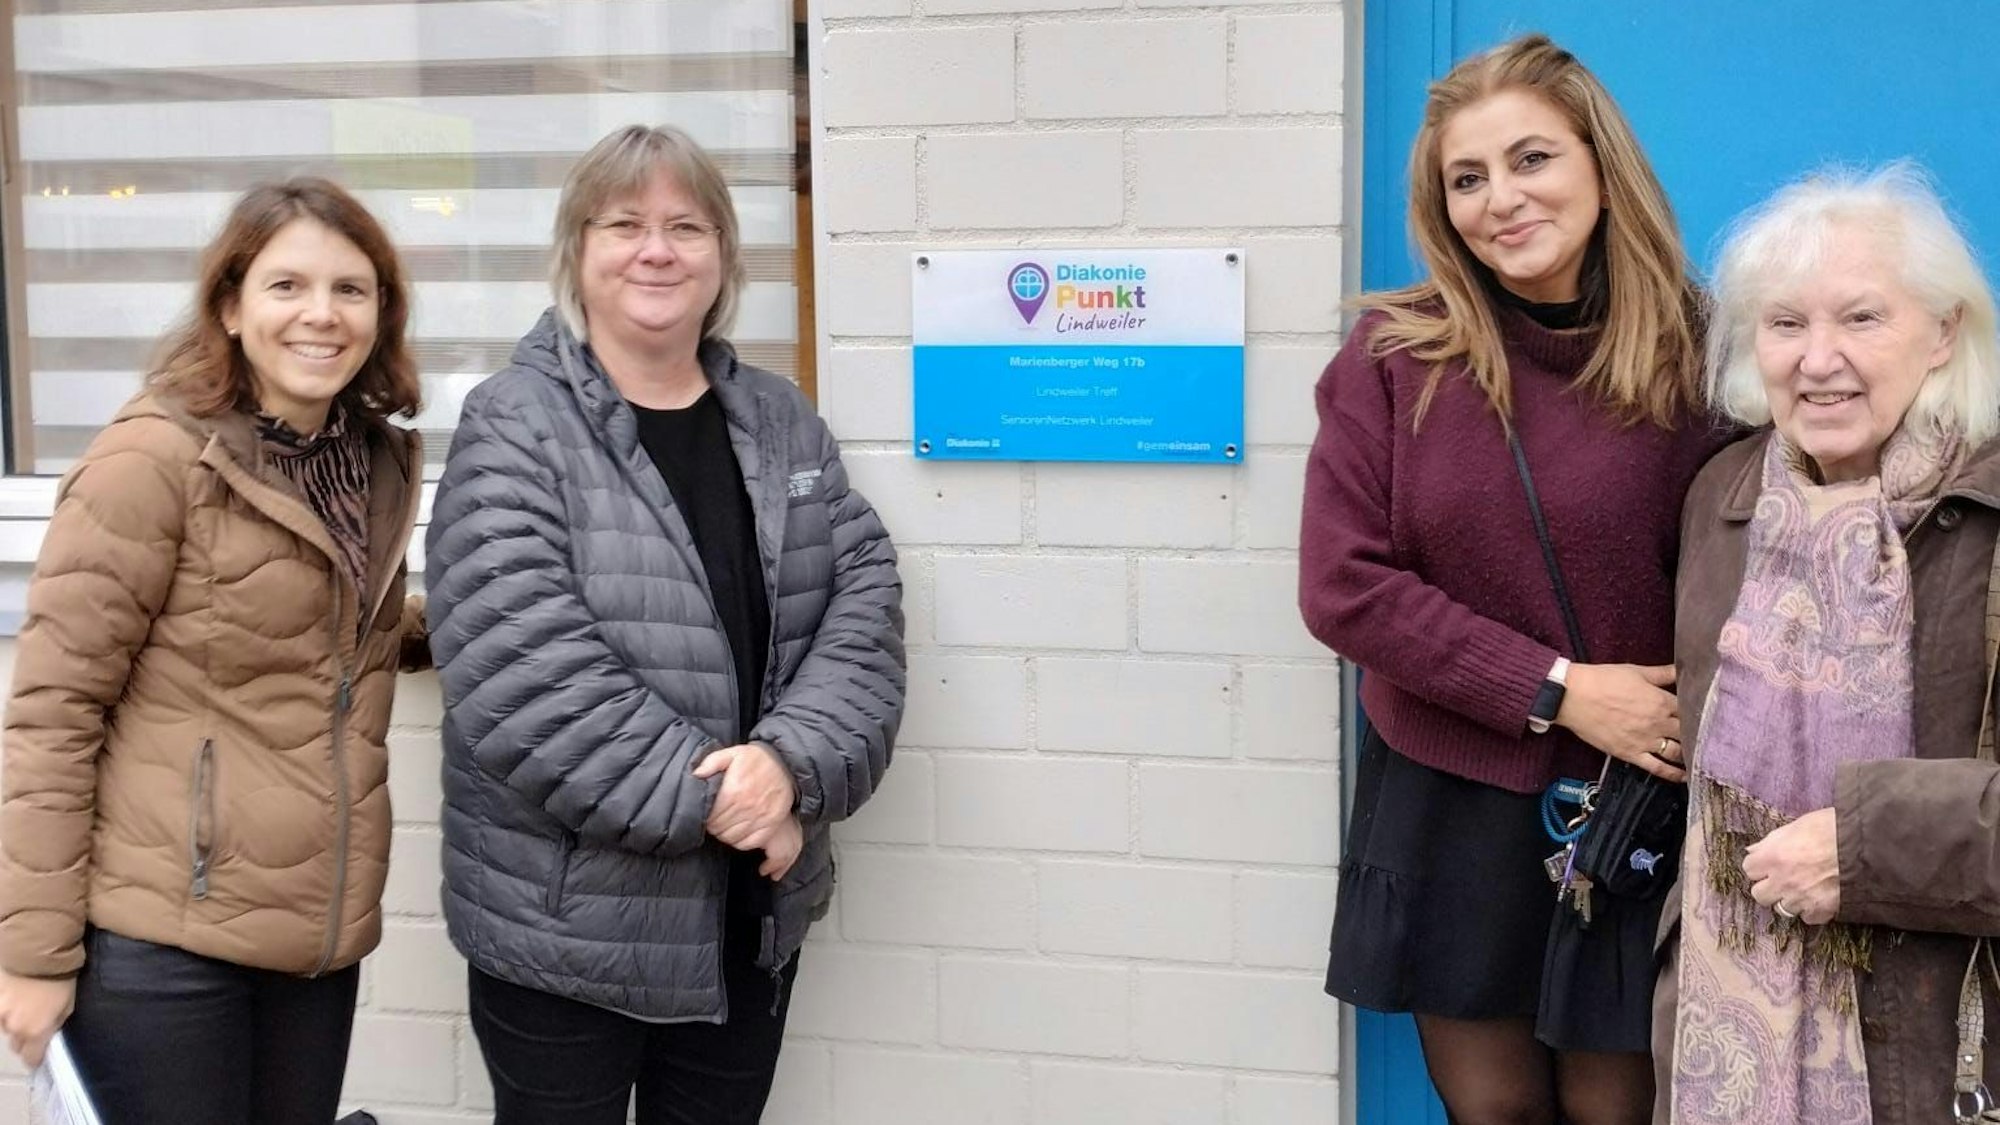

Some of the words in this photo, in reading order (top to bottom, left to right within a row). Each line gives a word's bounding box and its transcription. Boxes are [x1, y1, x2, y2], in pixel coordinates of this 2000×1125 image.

[1056, 264, 1147, 281] Diakonie
[1056, 285, 1147, 308] Punkt
[1056, 311, 1147, 333] Lindweiler
[1009, 356, 1089, 368] Marienberger
[1093, 356, 1120, 368] Weg
[1123, 356, 1146, 367] 17b
[1036, 386, 1089, 397] Lindweiler
[1094, 386, 1118, 397] Treff
[1000, 414, 1096, 426] SeniorenNetzwerk
[1100, 415, 1154, 427] Lindweiler
[946, 438, 990, 448] Diakonie
[1136, 440, 1211, 453] #gemeinsam
